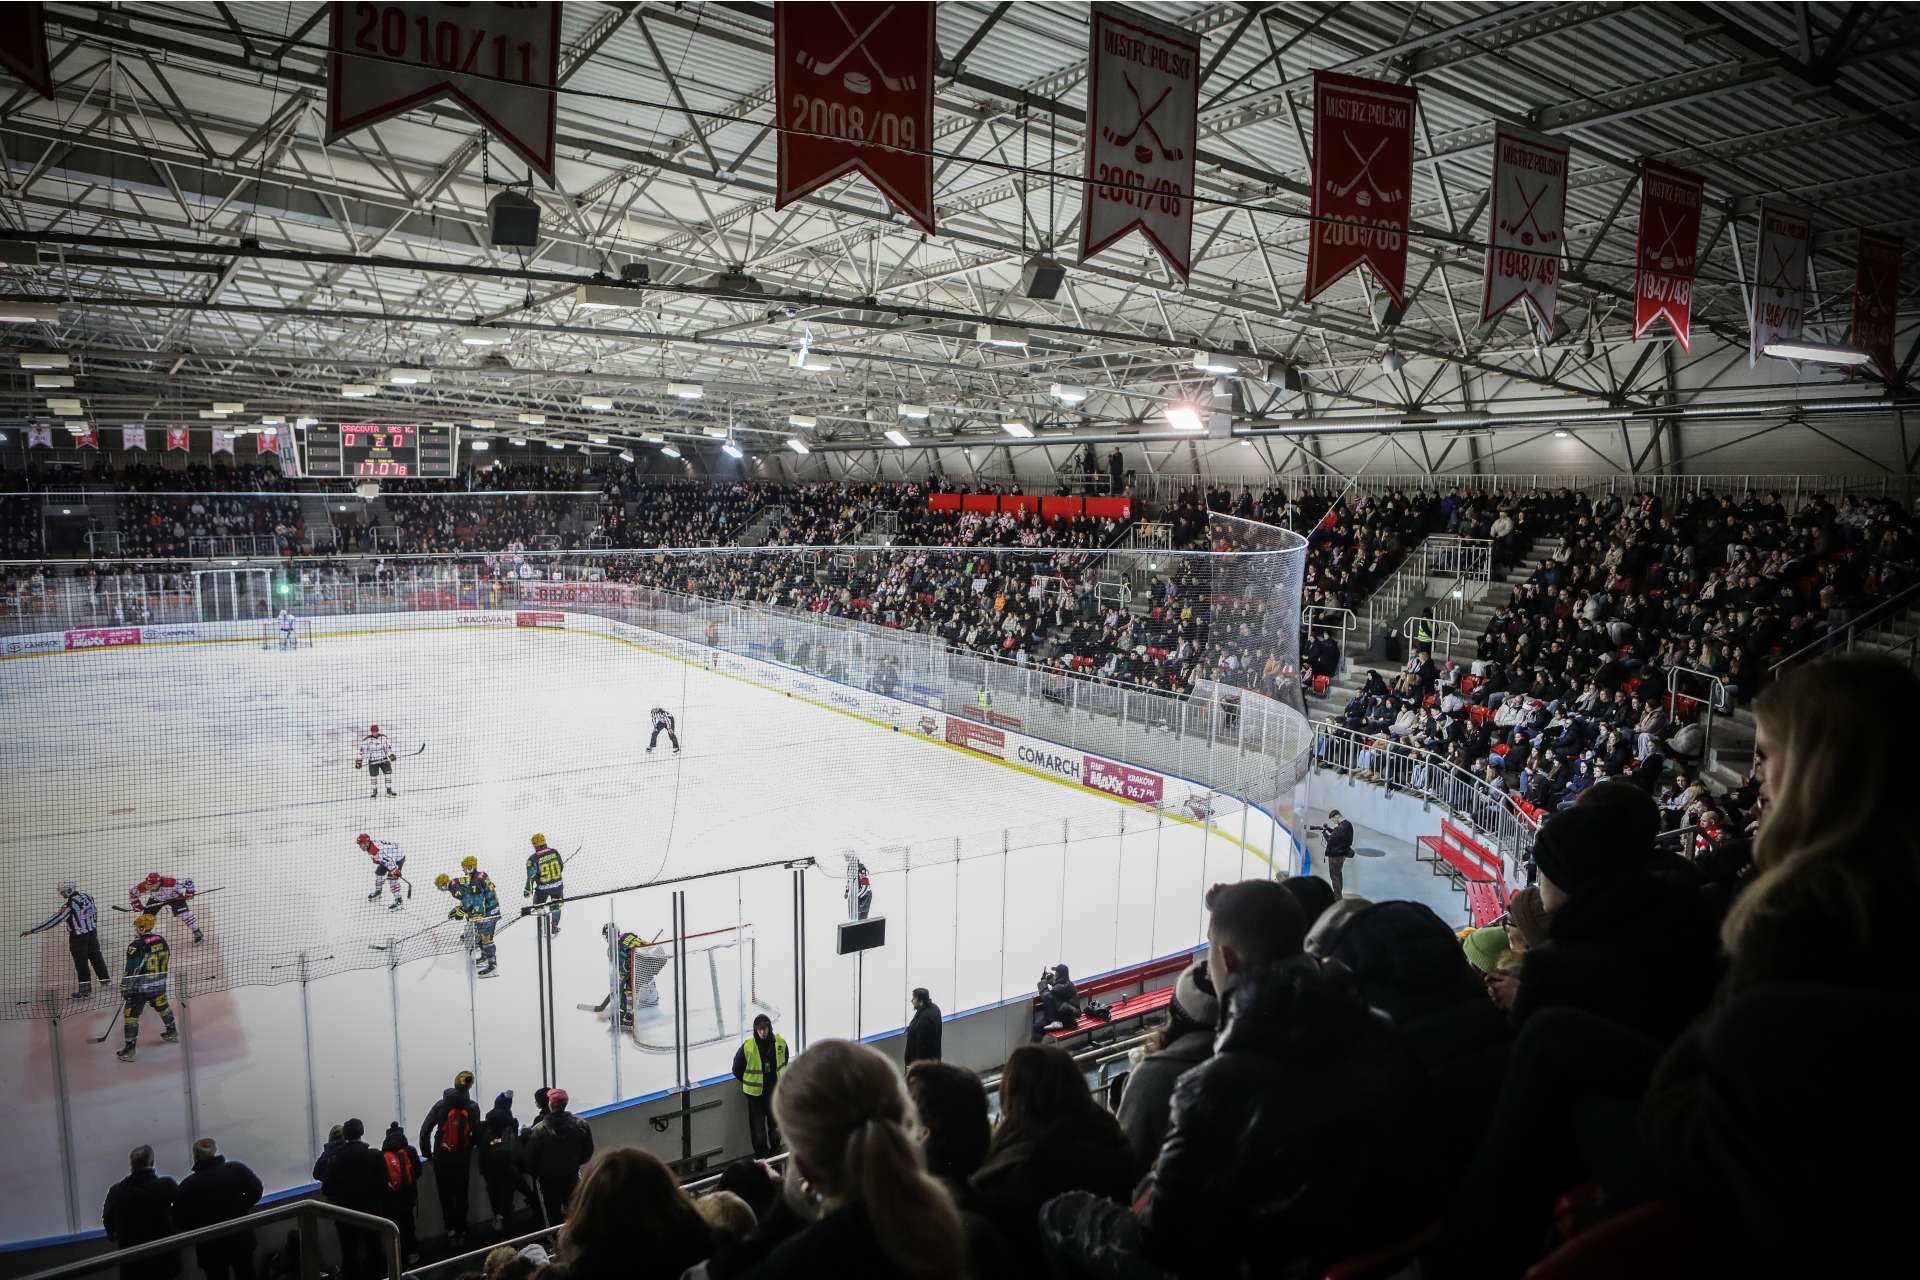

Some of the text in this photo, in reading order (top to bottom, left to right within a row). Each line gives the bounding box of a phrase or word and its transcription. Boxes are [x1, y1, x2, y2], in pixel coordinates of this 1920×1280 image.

[355, 2, 532, 82] 2010/11
[1151, 45, 1190, 80] POLSKI
[793, 94, 916, 156] 2008/09
[1325, 96, 1407, 129] MISTRZ POLSKI
[1502, 144, 1562, 178] MISTRZ POLSKI
[1098, 163, 1182, 217] 2007/08
[1498, 250, 1556, 285] 1948/49
[1642, 272, 1690, 306] 1947/48
[341, 424, 380, 433] CRACOVIA
[387, 425, 402, 434] GKS
[345, 433, 356, 447] 0
[392, 434, 403, 448] 0
[375, 437, 384, 448] 2
[24, 639, 59, 649] CANPACK
[162, 628, 196, 637] CANPACK
[1018, 745, 1080, 778] COMARCH
[1090, 761, 1105, 771] RMF
[1127, 774, 1155, 787] KRAKÓW
[1127, 785, 1155, 799] 96.7 FM
[540, 859, 562, 883] 90
[146, 950, 169, 979] 97
